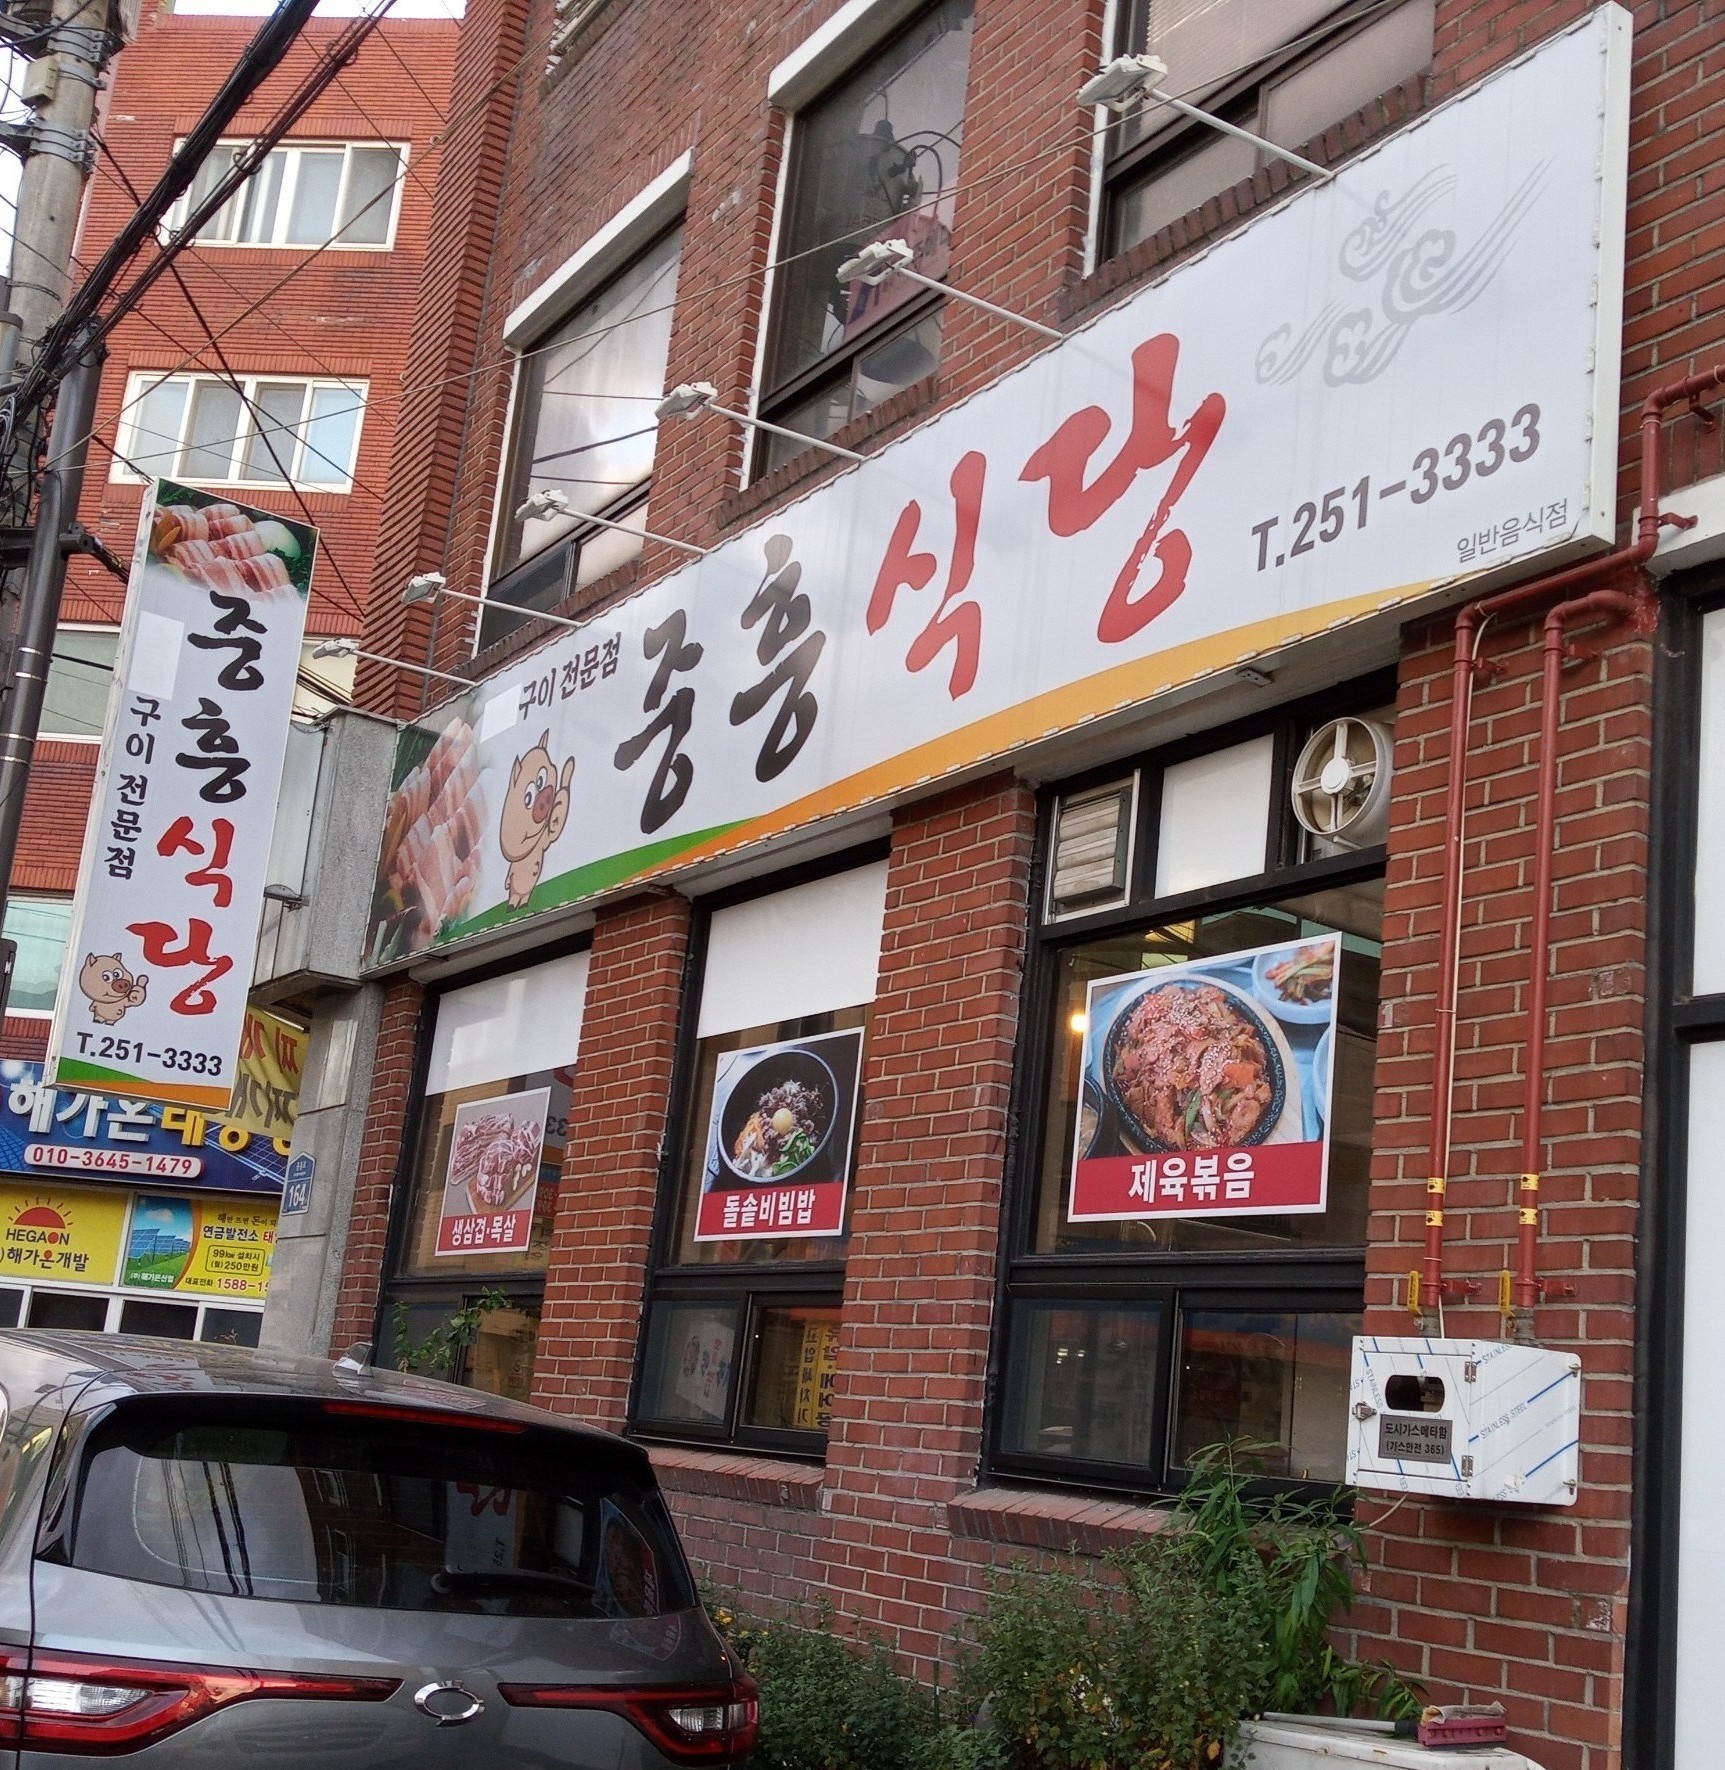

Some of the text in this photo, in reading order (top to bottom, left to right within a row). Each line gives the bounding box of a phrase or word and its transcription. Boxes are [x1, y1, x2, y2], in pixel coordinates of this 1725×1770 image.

[1251, 403, 1541, 572] T.251-3333
[1457, 498, 1567, 563] 일반음식점
[519, 632, 622, 720] 구이 전문점
[76, 1031, 223, 1077] T.251-3333
[32, 1146, 193, 1175] 010-3645-1479
[1129, 1152, 1255, 1203] 제육볶음
[288, 1183, 307, 1208] 164
[723, 1189, 816, 1229] 돌솥비빔밥
[6, 1228, 70, 1246] HEGAON
[203, 1225, 259, 1241] 연금발전소
